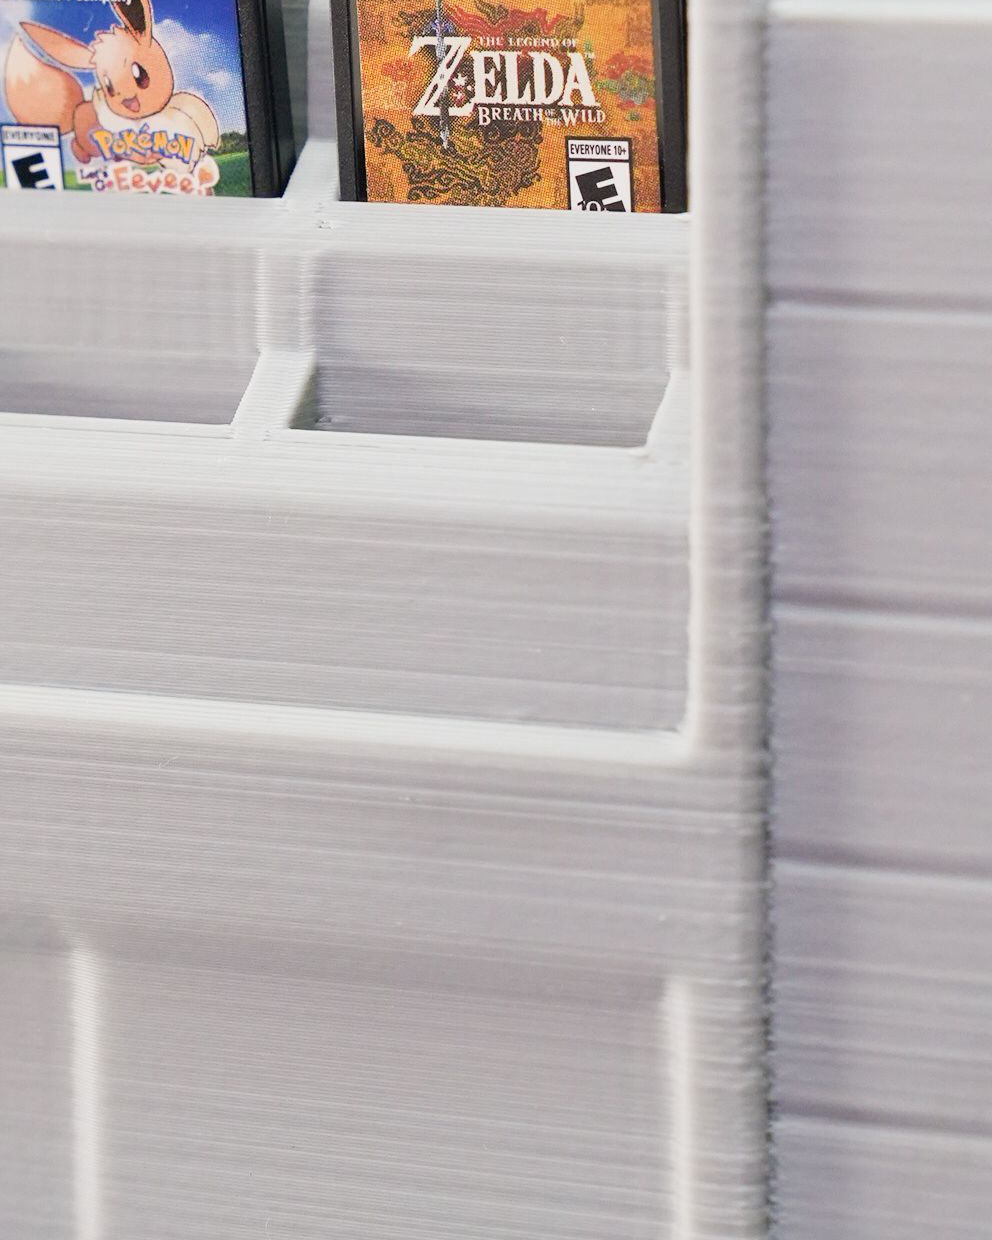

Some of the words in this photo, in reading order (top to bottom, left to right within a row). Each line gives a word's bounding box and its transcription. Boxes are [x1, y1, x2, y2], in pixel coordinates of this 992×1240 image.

[477, 37, 504, 46] THE
[508, 38, 560, 47] LEGEND
[408, 36, 602, 117] ZELDA
[478, 107, 543, 126] BREATH
[560, 109, 606, 127] WILD
[570, 143, 611, 156] EVERYONE
[614, 145, 627, 156] 10+
